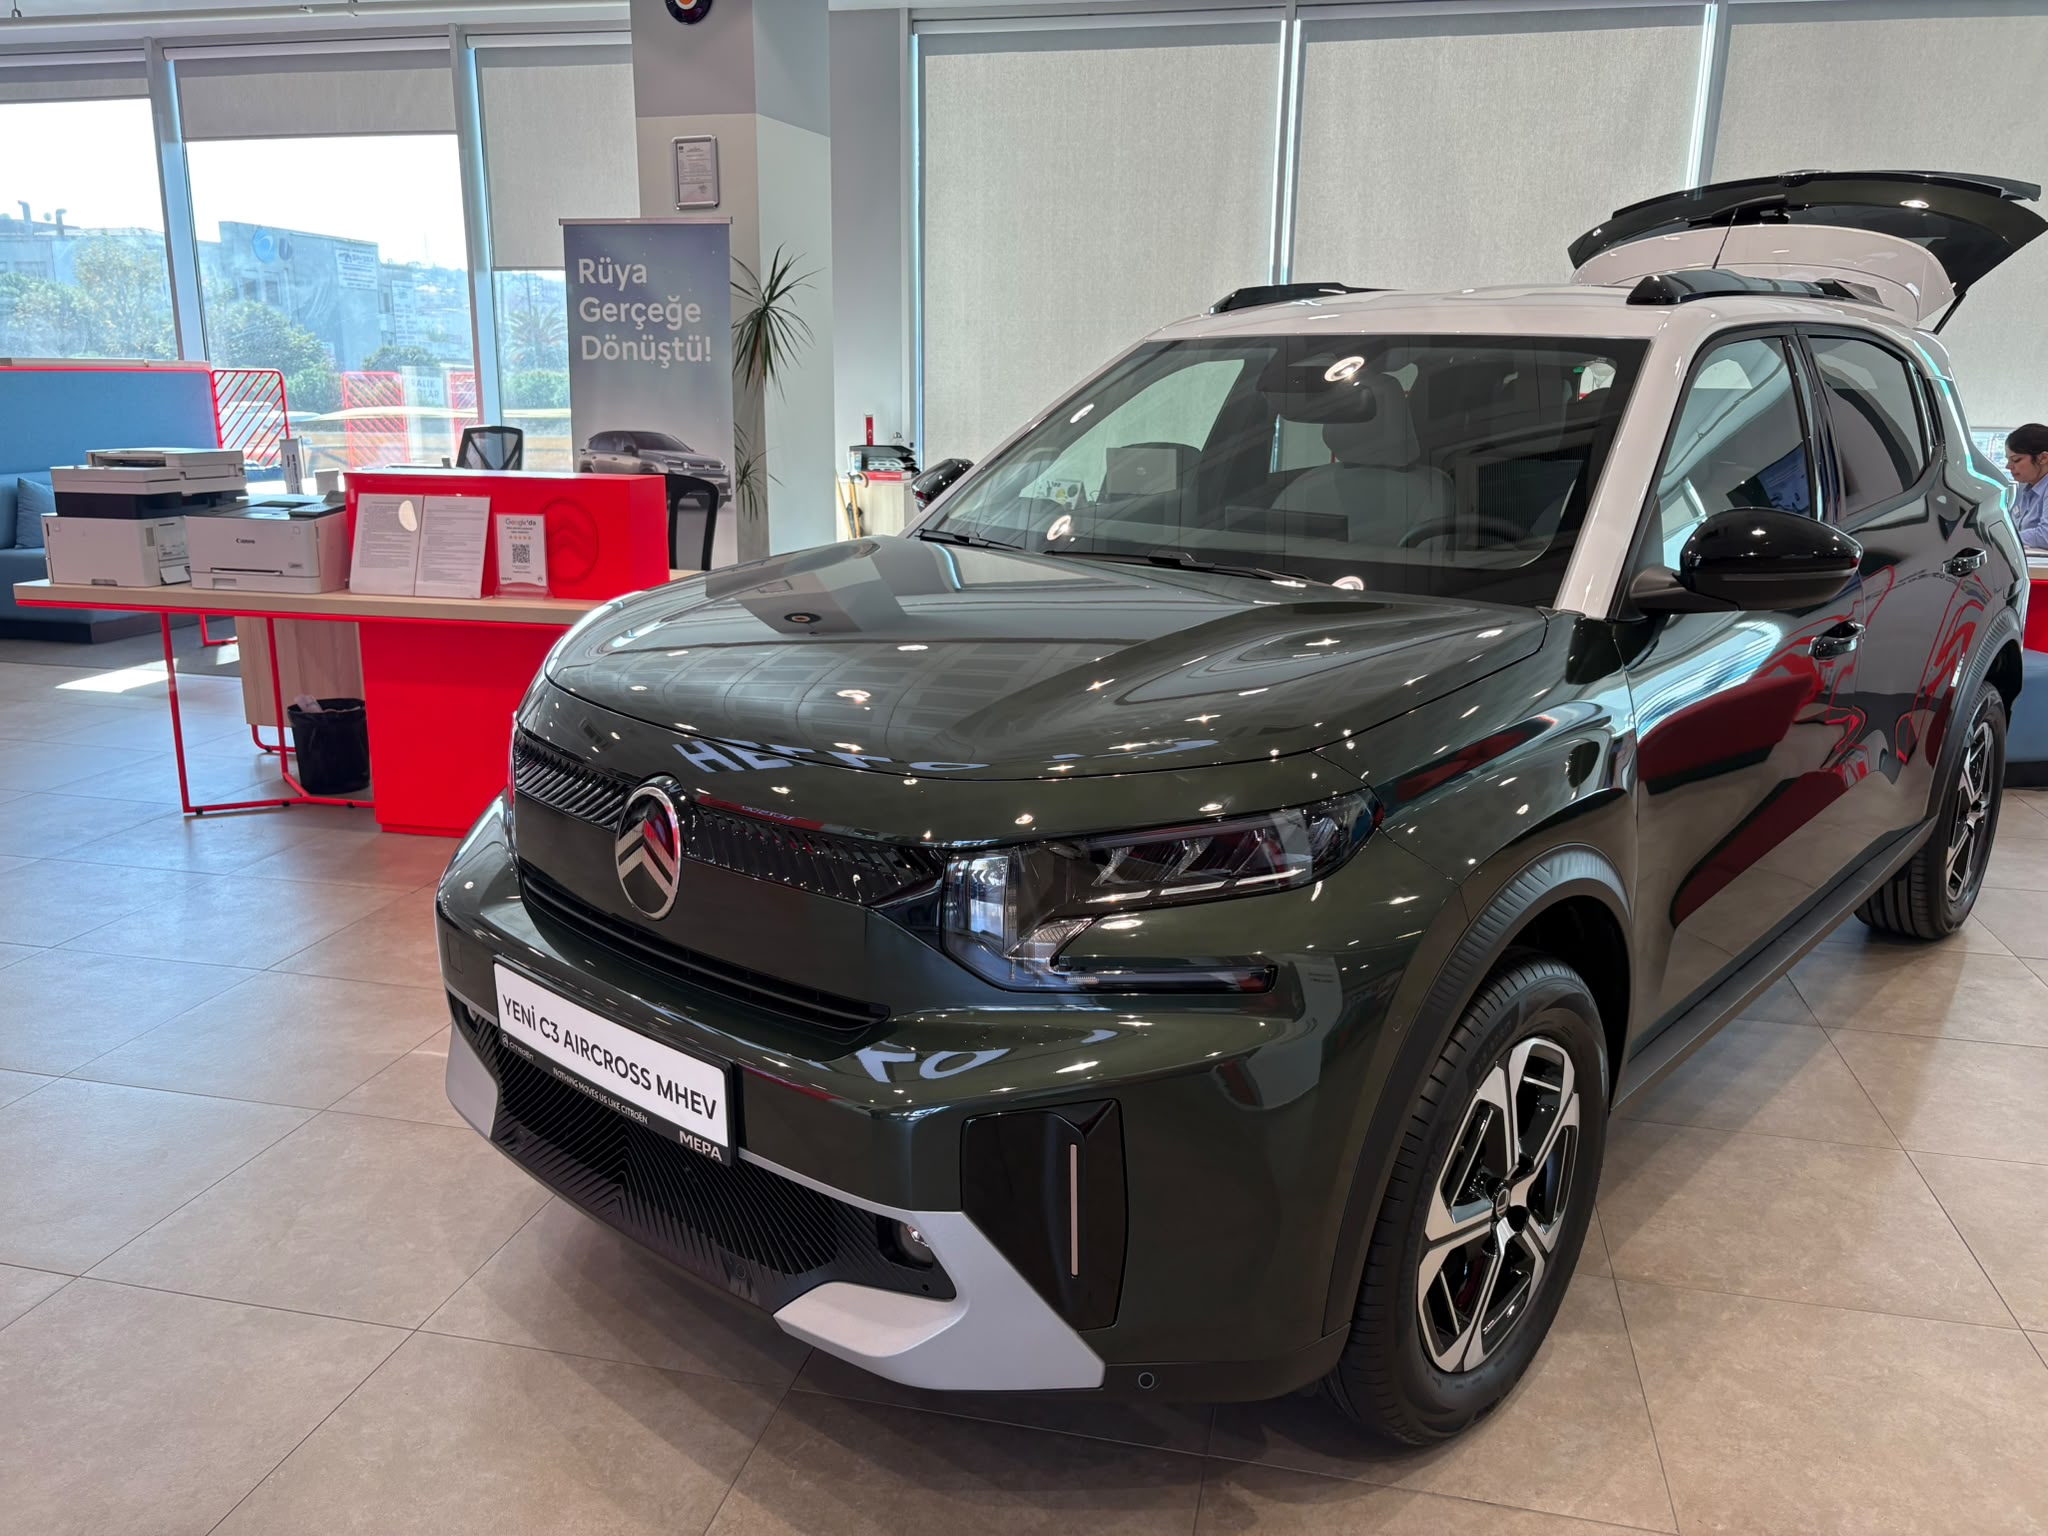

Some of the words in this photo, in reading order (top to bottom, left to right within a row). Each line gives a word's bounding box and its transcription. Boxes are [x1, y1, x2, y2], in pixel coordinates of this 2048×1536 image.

[578, 256, 648, 292] Rüya
[579, 295, 702, 331] Gerçeğe
[581, 334, 712, 369] Dönüştü!
[502, 994, 537, 1031] YENİ
[540, 1016, 560, 1043] C3
[564, 1029, 651, 1091] AIRCROSS
[656, 1074, 717, 1120] MHEV
[553, 1066, 579, 1088] NOTHING
[579, 1082, 599, 1100] MOVES
[599, 1093, 608, 1105] US
[608, 1098, 621, 1111] LIKE
[679, 1130, 722, 1162] MEPA
